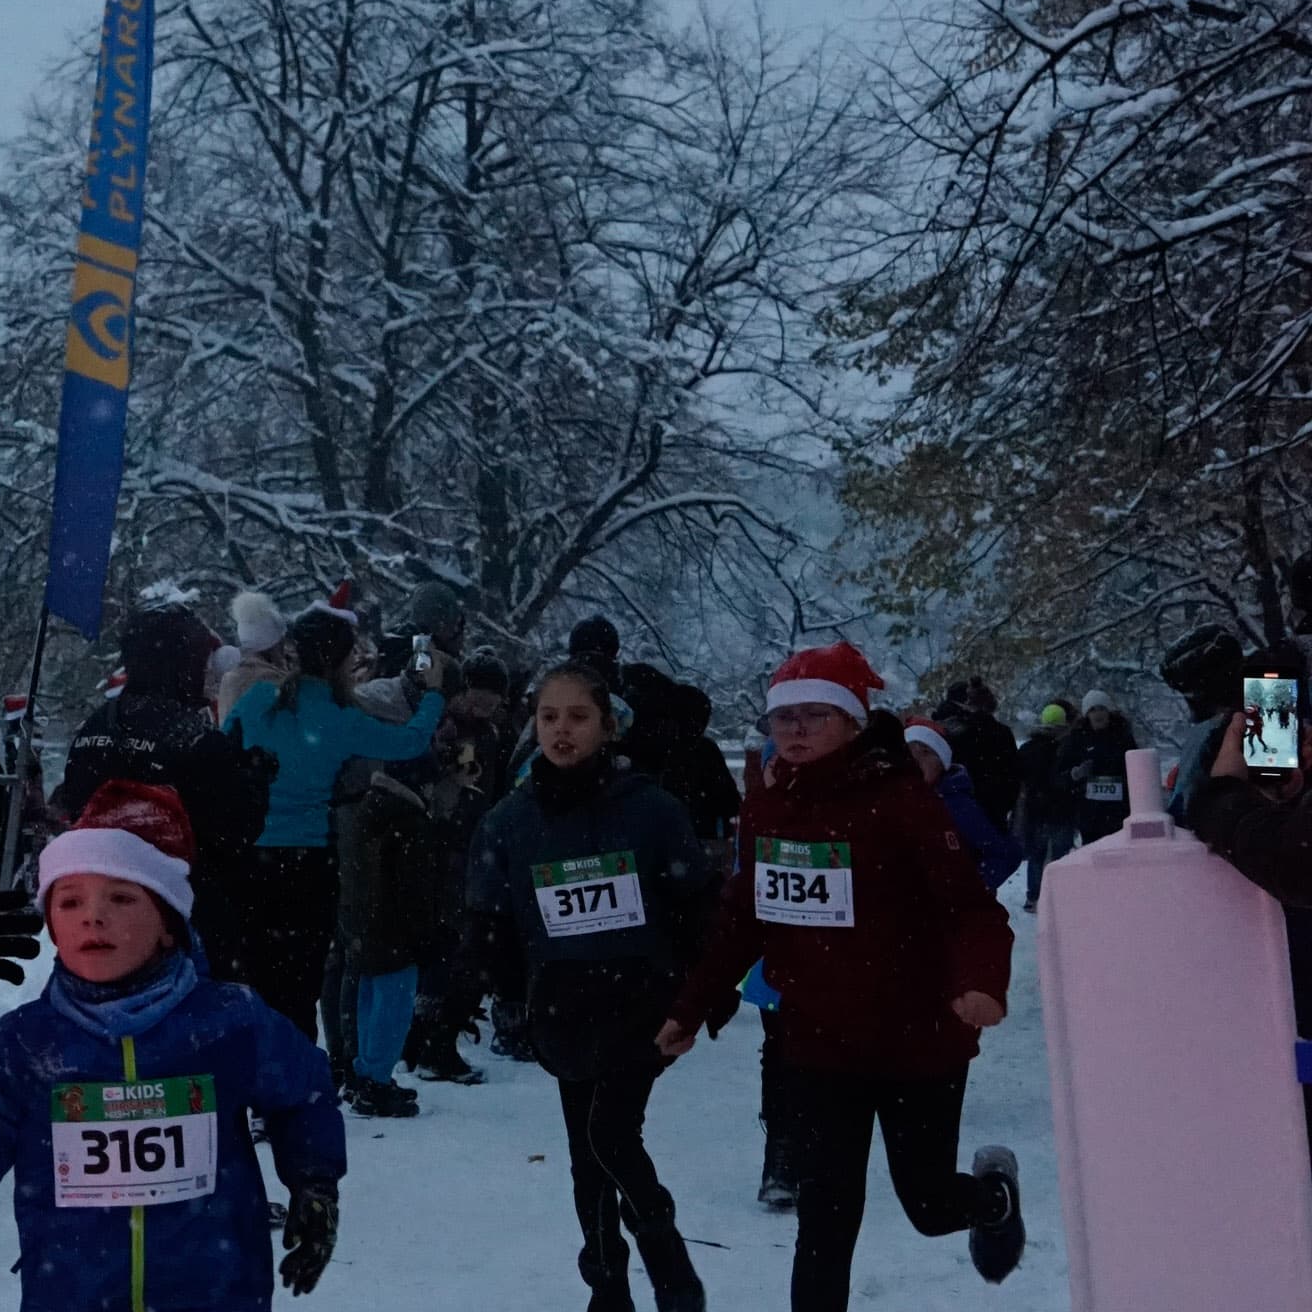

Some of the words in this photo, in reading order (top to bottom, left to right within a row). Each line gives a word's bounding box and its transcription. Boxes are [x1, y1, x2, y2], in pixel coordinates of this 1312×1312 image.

[577, 857, 601, 869] KIDS
[555, 882, 617, 917] 3171
[766, 869, 829, 904] 3134
[125, 1082, 165, 1099] KIDS
[82, 1125, 184, 1175] 3161
